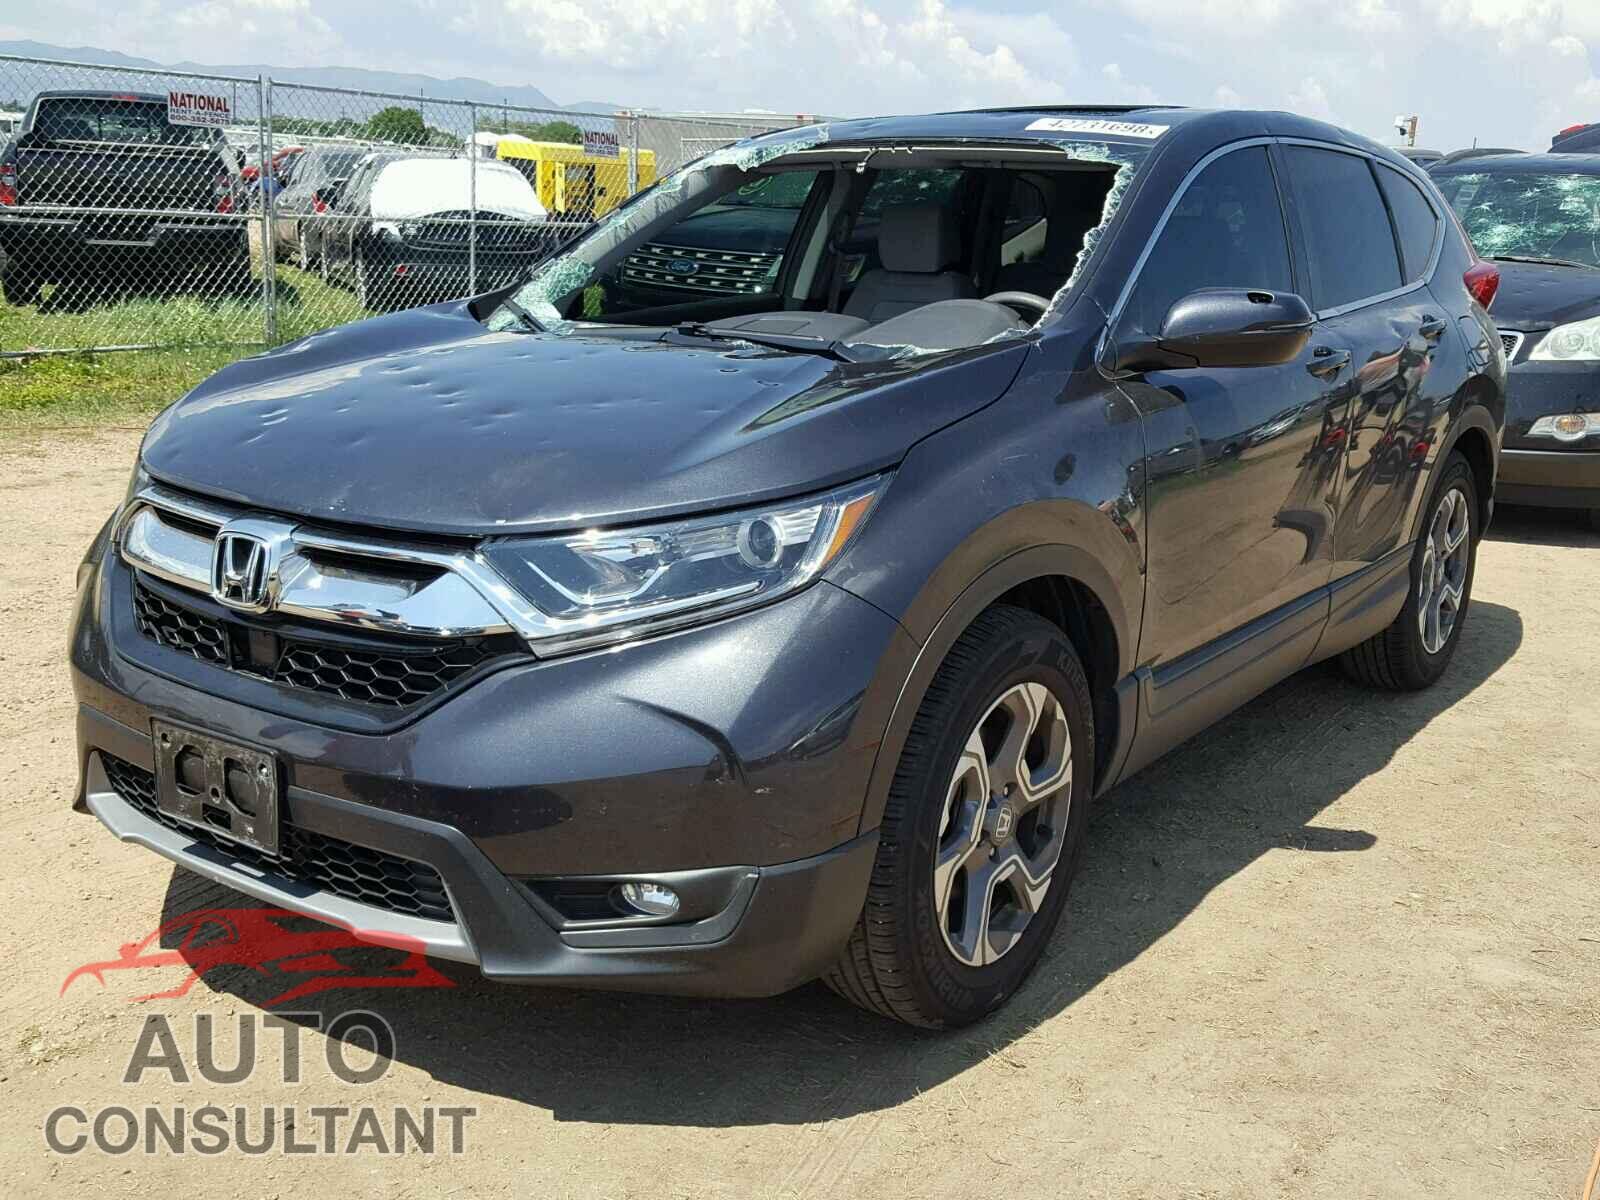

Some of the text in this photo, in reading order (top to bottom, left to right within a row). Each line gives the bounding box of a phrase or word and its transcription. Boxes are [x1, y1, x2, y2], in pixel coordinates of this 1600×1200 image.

[170, 92, 230, 112] NATIONAL
[170, 108, 230, 119] RENT-A-FENCE
[584, 130, 619, 146] NATIONAL
